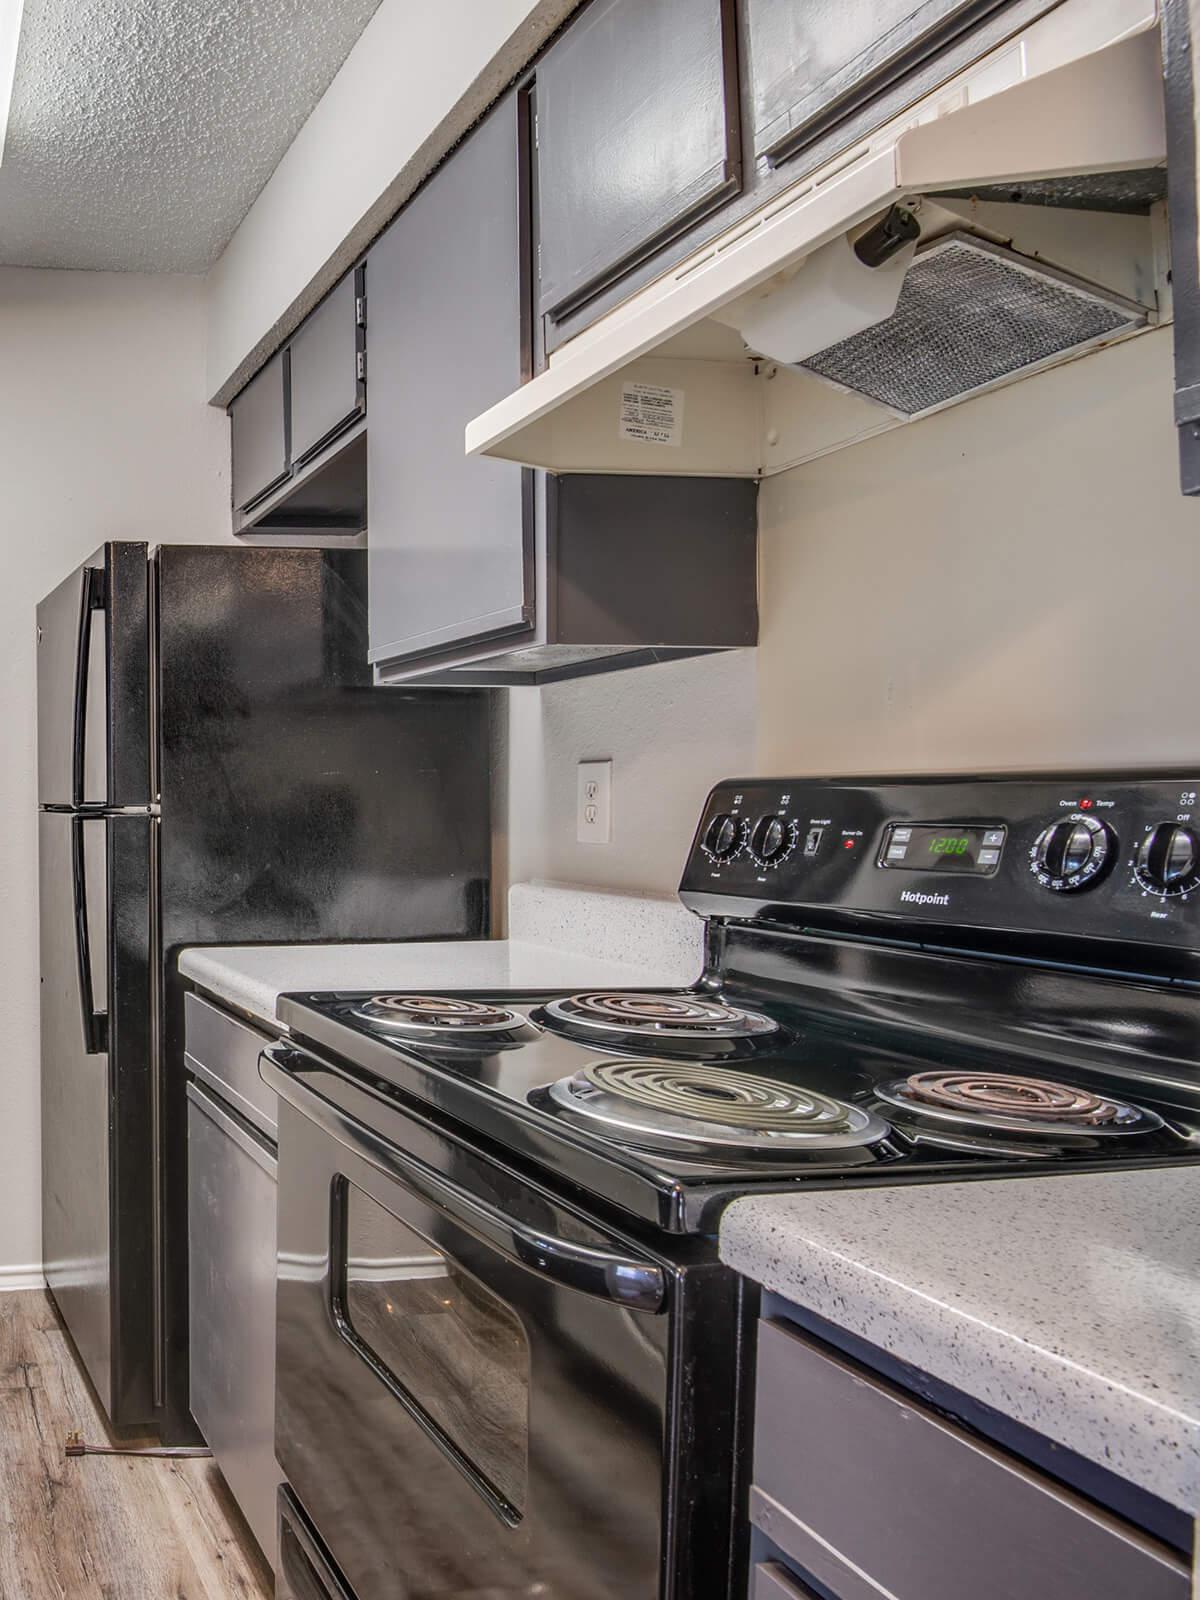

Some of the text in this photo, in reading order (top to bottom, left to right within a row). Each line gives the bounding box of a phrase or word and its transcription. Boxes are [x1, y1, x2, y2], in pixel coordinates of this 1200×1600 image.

[1096, 800, 1115, 809] Temp
[1177, 813, 1191, 821] Off
[900, 890, 950, 905] Hotpoint
